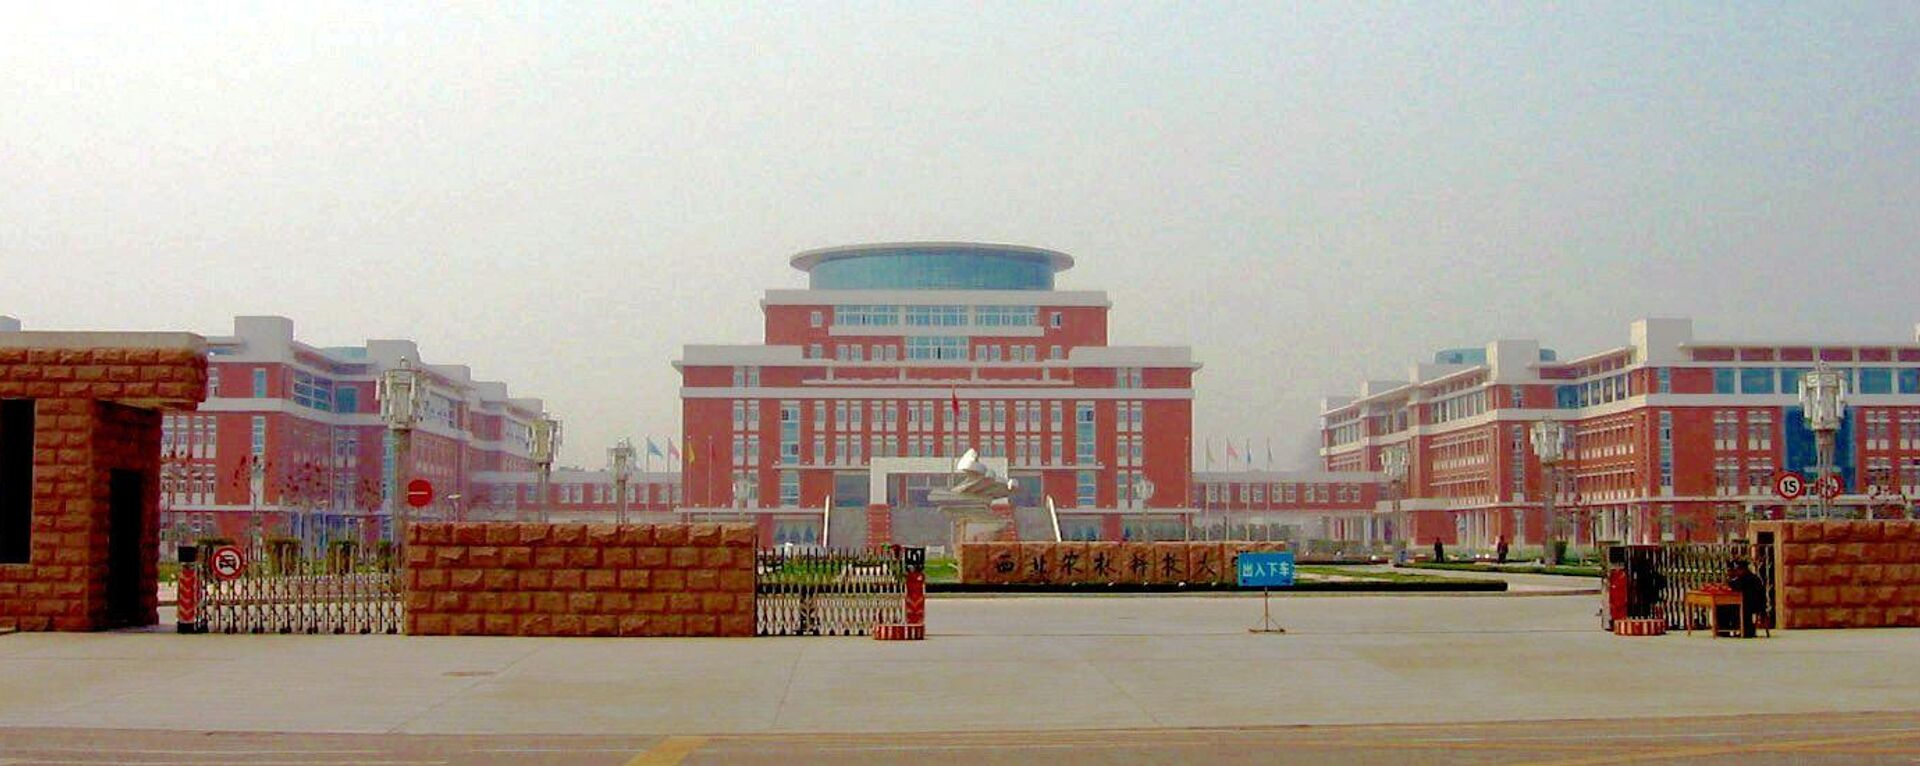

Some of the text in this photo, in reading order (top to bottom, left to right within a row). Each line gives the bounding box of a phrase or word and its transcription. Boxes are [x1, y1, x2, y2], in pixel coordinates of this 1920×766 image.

[1783, 480, 1797, 493] 15
[995, 551, 1239, 578] 西北农林科技大
[1242, 560, 1290, 577] 出入下车
